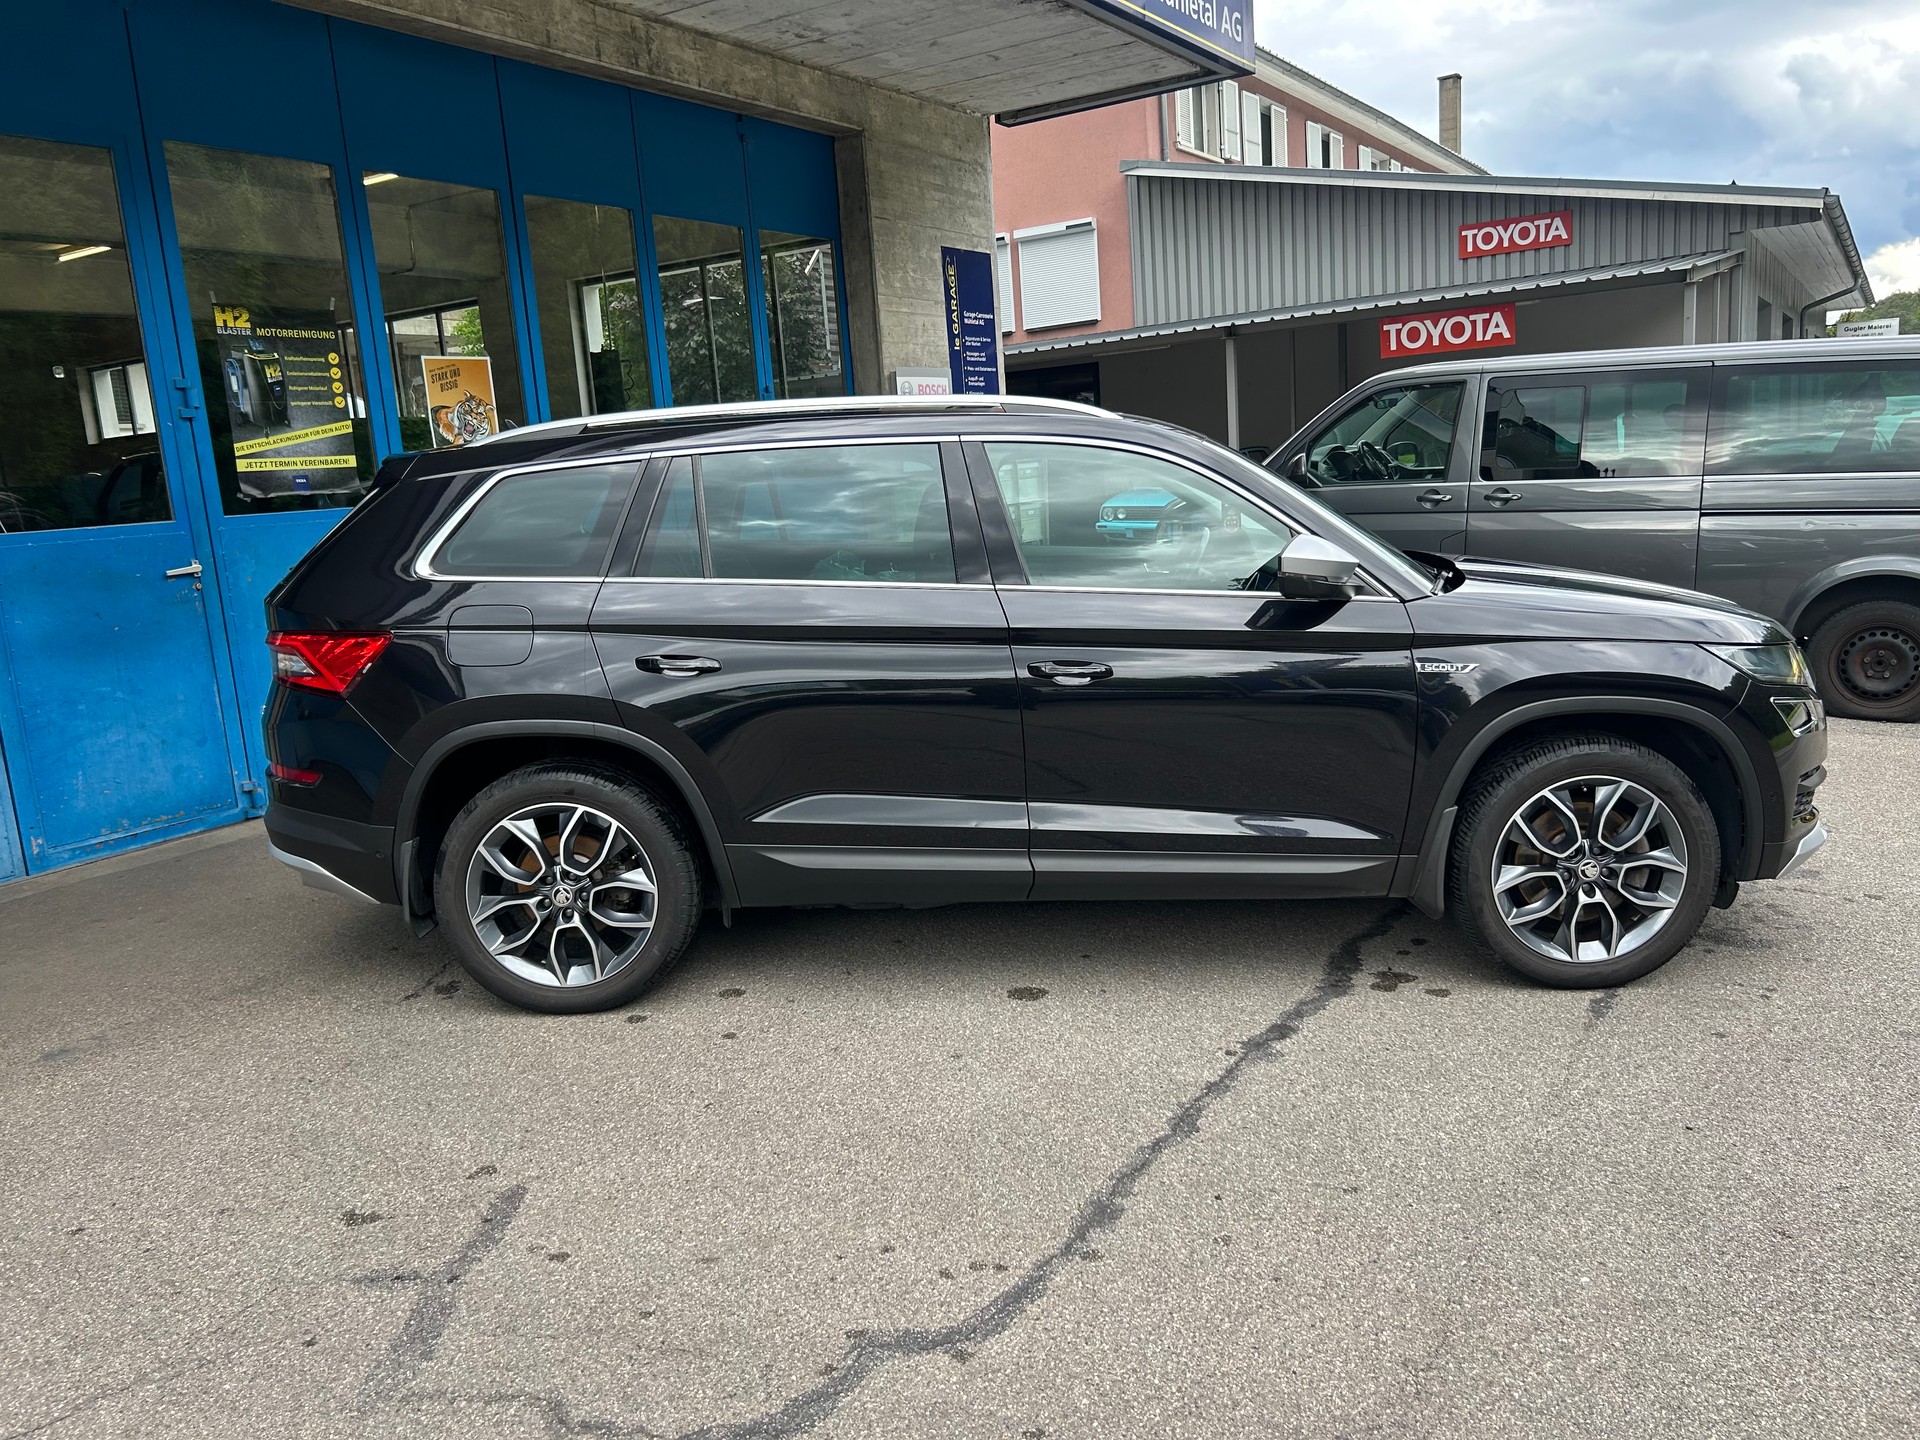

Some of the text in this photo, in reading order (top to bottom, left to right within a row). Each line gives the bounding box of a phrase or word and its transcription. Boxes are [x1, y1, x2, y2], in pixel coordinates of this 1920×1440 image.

[1221, 6, 1242, 42] AG
[1461, 217, 1568, 252] TOYOTA
[948, 264, 960, 350] le GARAGE
[213, 306, 251, 328] H2
[216, 327, 252, 336] BLASTER
[256, 328, 336, 339] MOTORREINIGUNG
[1383, 311, 1511, 351] TOYOTA
[431, 370, 449, 384] STARK
[449, 367, 461, 379] UND
[440, 379, 458, 392] BISSIG
[917, 384, 947, 395] BOSCH
[235, 424, 351, 453] DIE ENTSCHLACKUNGSKUR FÜR DEIN AUTO!
[244, 458, 350, 469] JETZT TERMIN VEREINBAREN!
[1424, 663, 1464, 671] SCOUT
